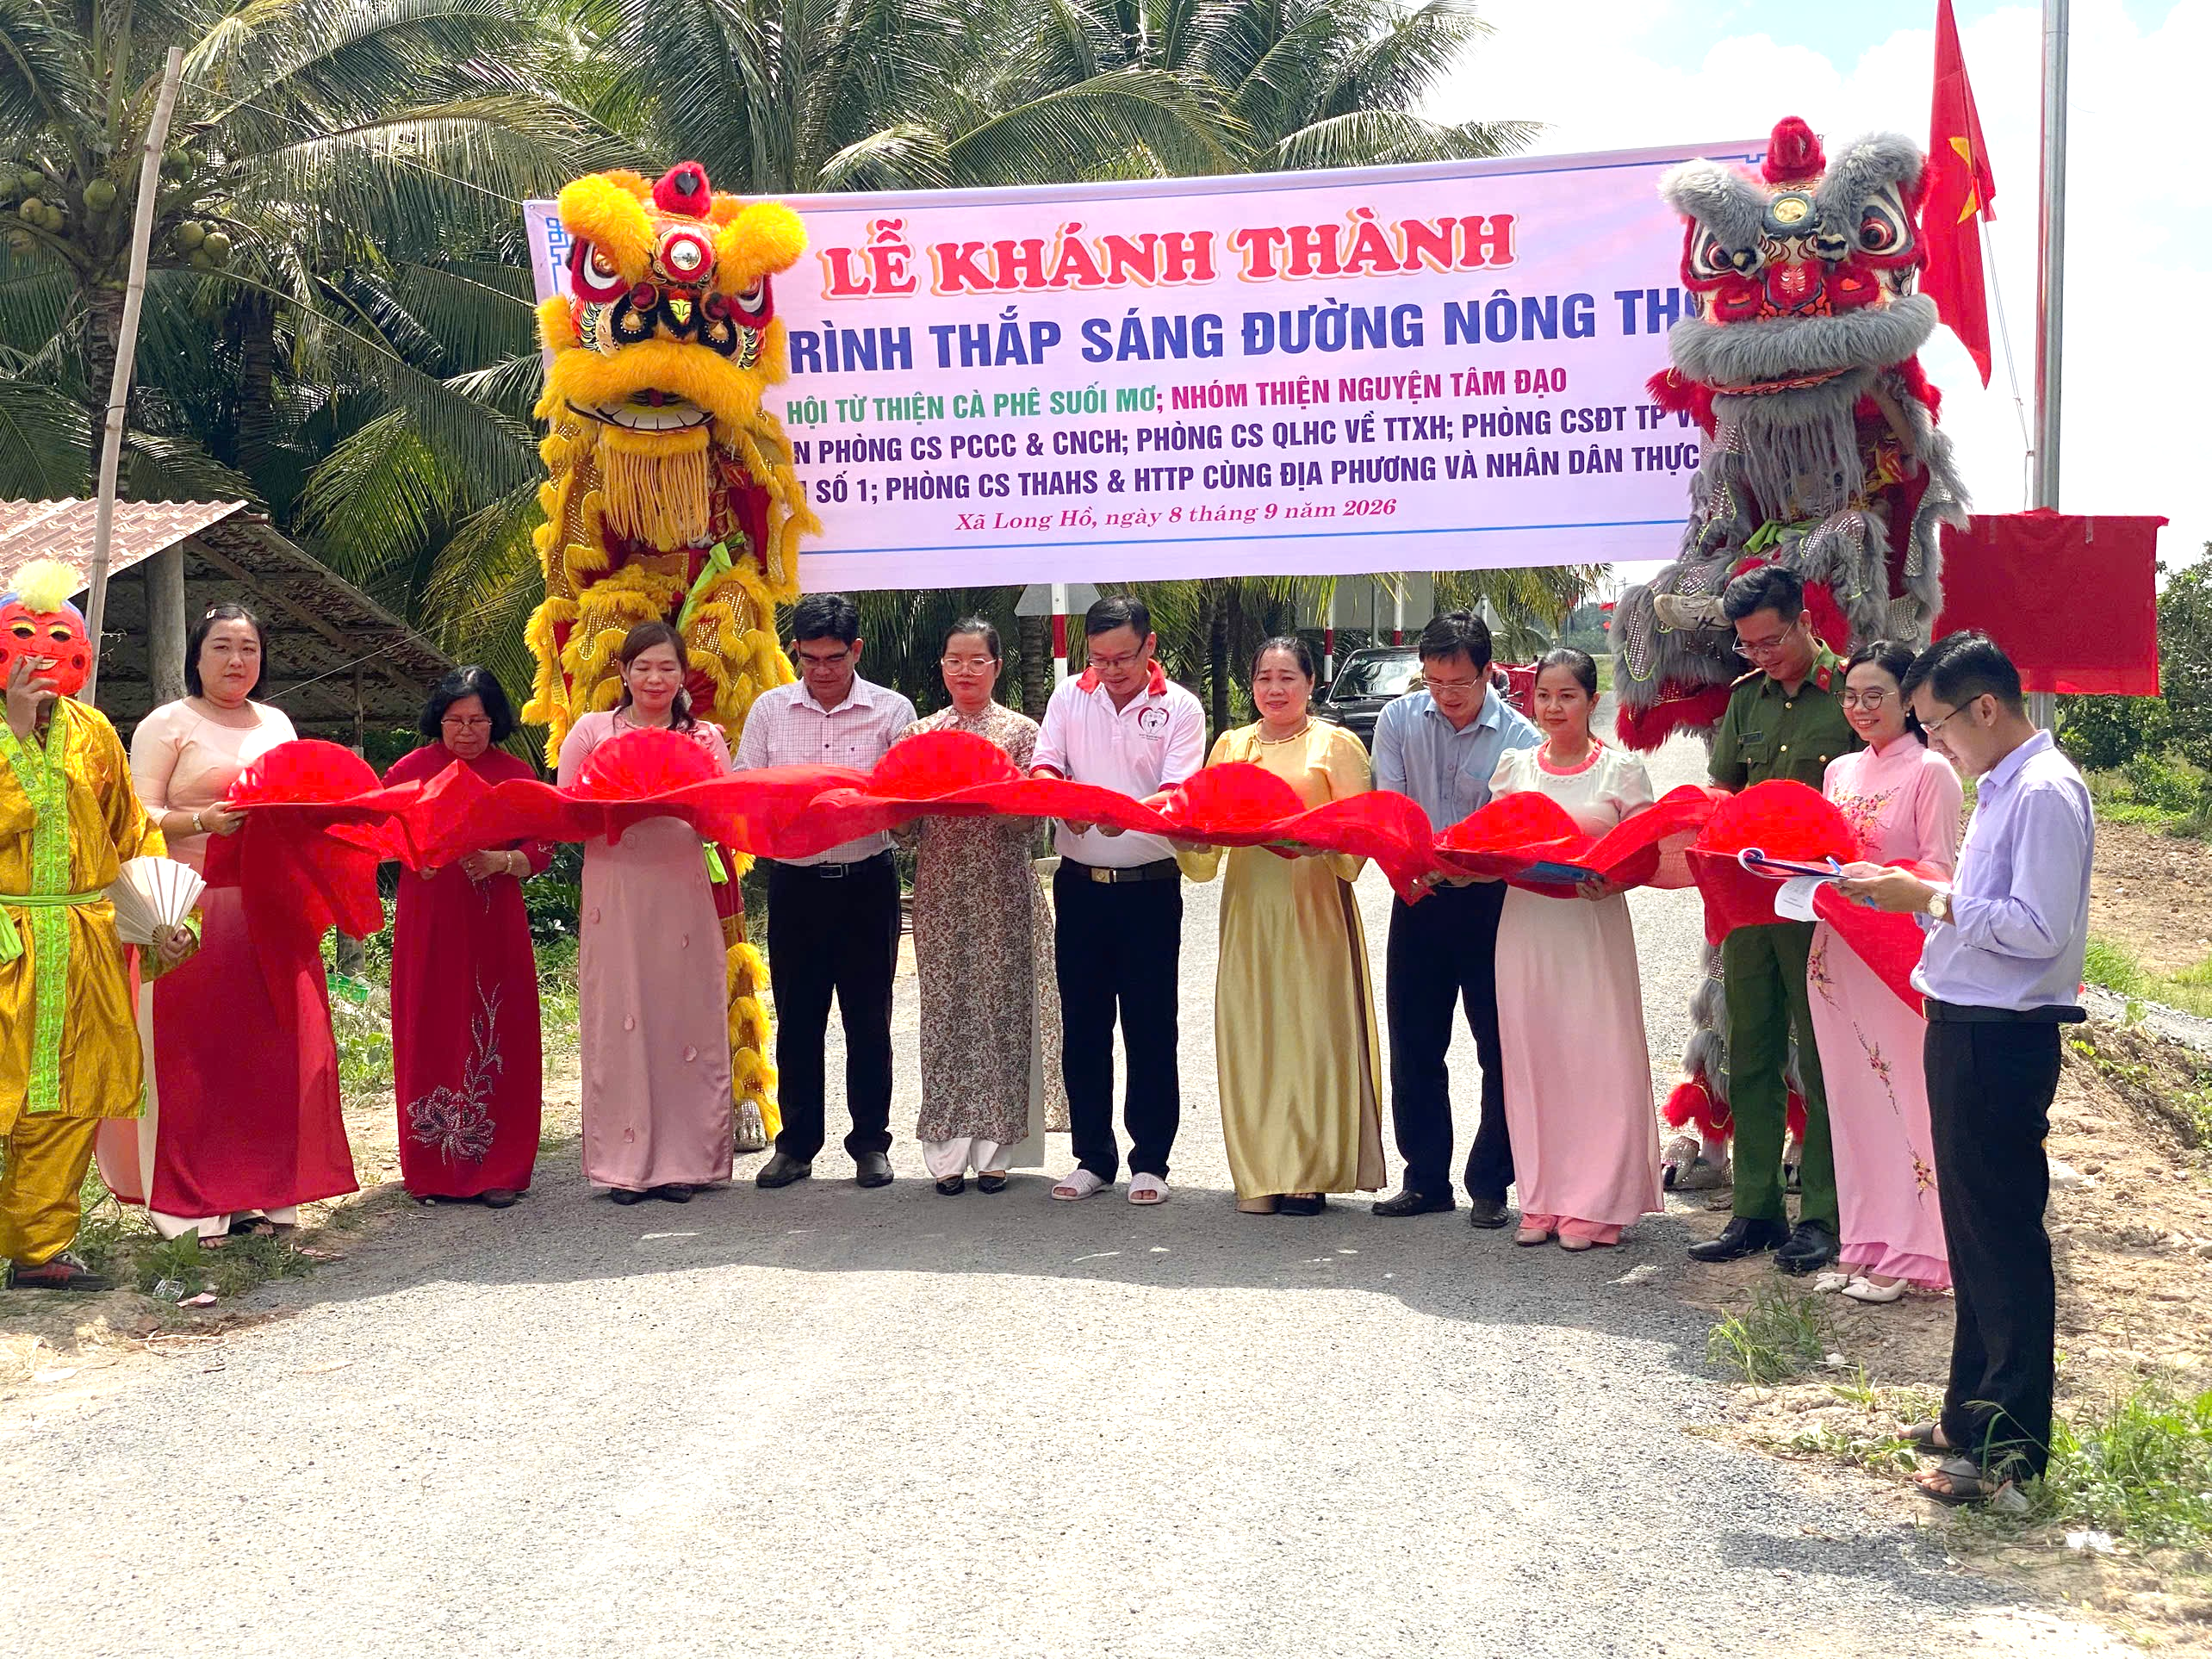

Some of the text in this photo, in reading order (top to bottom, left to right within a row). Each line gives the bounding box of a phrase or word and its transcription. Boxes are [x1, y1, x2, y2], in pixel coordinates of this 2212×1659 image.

[817, 206, 1519, 301] LỄ KHÁNH THÀNH
[789, 320, 912, 374] RÌNH
[929, 305, 1060, 368] THẮP
[1082, 308, 1223, 363] SÁNG
[1241, 297, 1423, 356] ĐƯỜNG
[1444, 289, 1595, 345] NÔNG
[787, 367, 1566, 429] HỘI TỪ THIỆN CÀ PHÊ SUỐI MƠ; NHÓM THIỆN NGUYỆN TÂM ĐẠO
[819, 433, 902, 463] PHÒNG
[910, 436, 941, 460] CS
[951, 433, 1016, 458] PCCC
[1026, 433, 1043, 456] &
[1053, 429, 1128, 456] CNCH;
[1137, 420, 1221, 451] PHÒNG
[1232, 424, 1263, 448] CS
[1273, 420, 1336, 449] QLHC
[1345, 411, 1375, 443] VỀ
[1383, 415, 1452, 442] TTXH;
[1463, 407, 1550, 438] PHÒNG
[1561, 407, 1626, 433] CSĐT
[1635, 405, 1667, 430] TP
[817, 470, 848, 503] SỐ
[857, 479, 877, 505] 1;
[886, 470, 969, 500] PHÒNG
[979, 474, 1010, 497] CS
[1018, 470, 1097, 496] THAHS
[1108, 469, 1125, 493] &
[1134, 467, 1194, 492] HTTP
[1203, 460, 1271, 489] CÙNG
[1280, 462, 1323, 491] ĐỊA
[1332, 456, 1436, 484] PHƯƠNG
[1445, 450, 1477, 479] VÀ
[1487, 447, 1559, 478] NHÂN
[1569, 444, 1622, 475] DÂN
[1631, 442, 1699, 471] THỰC
[954, 499, 1396, 531] Xã Long Hồ, ngày 8 tháng 9 năm 2026
